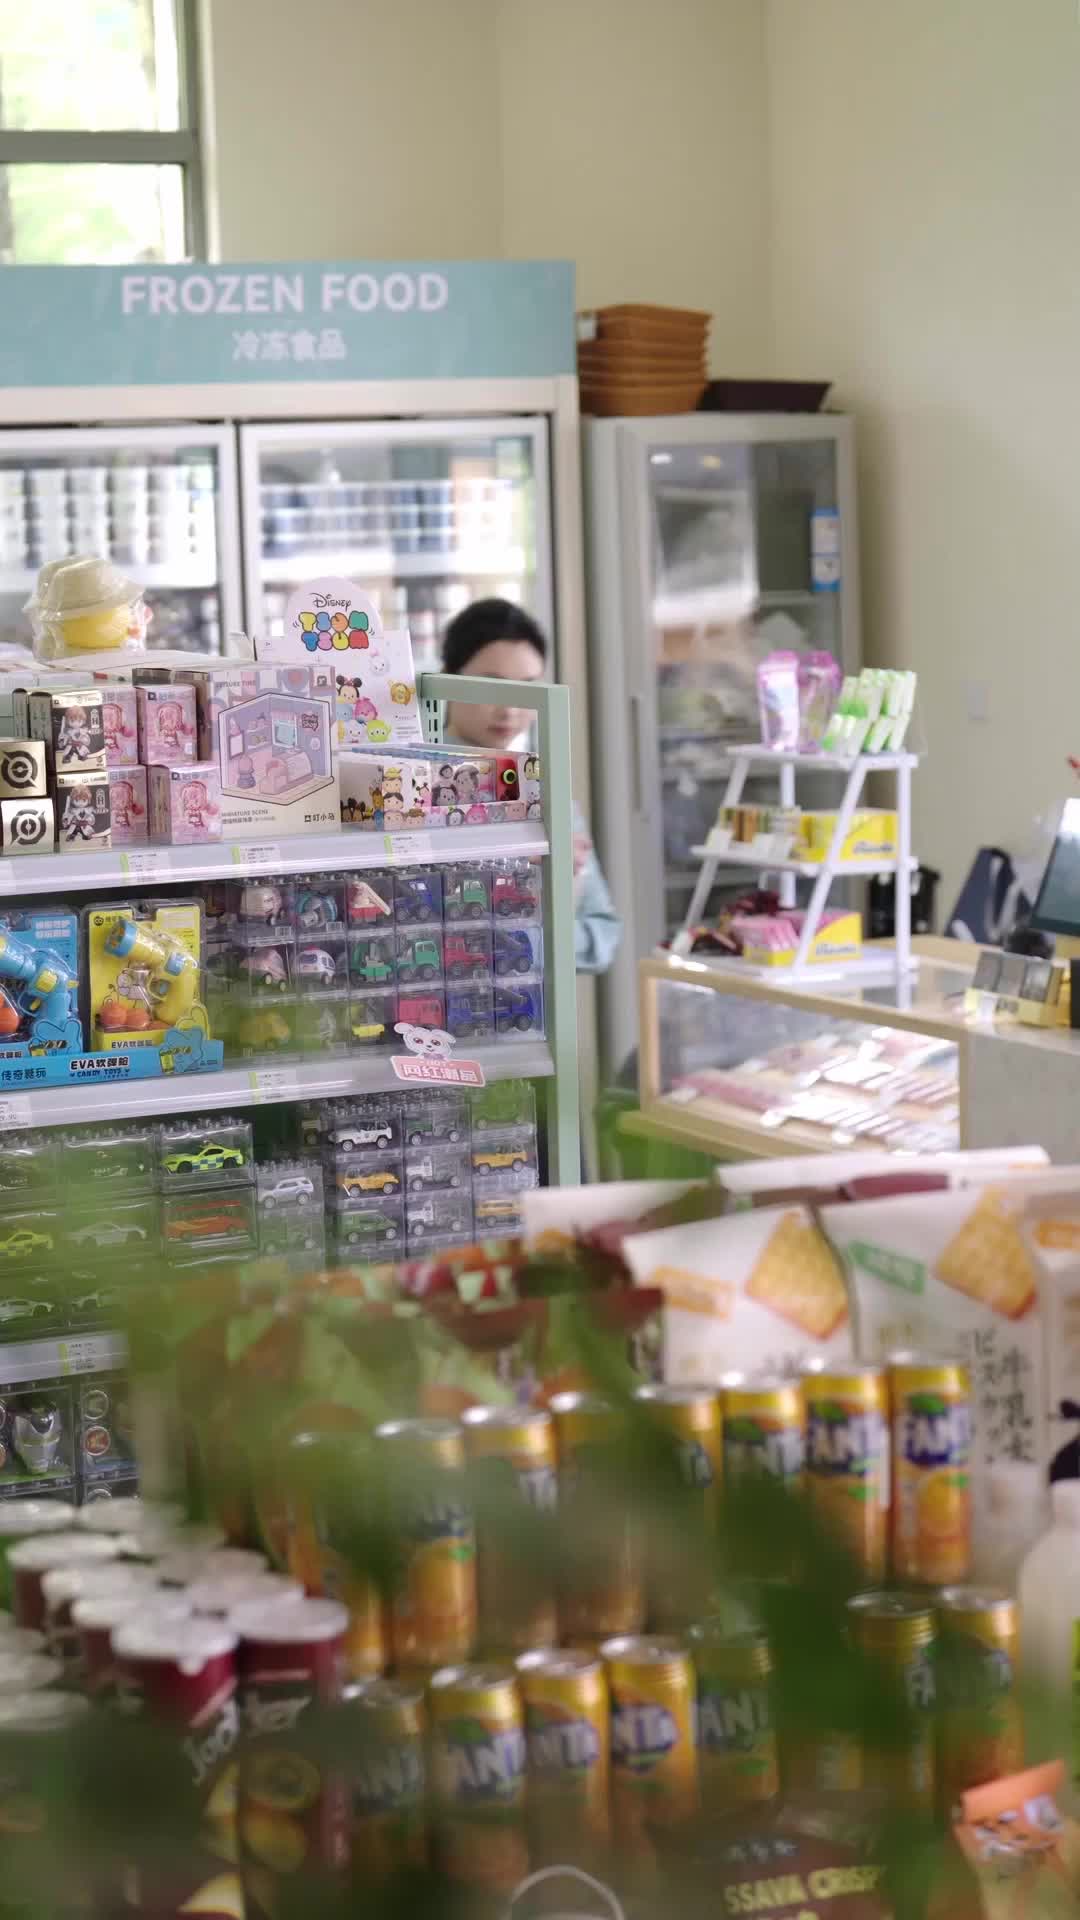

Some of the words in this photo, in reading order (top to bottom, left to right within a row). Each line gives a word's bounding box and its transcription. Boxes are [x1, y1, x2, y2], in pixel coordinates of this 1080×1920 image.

[121, 274, 304, 315] FROZEN
[321, 272, 449, 311] FOOD
[232, 328, 346, 361] 冷冻食品
